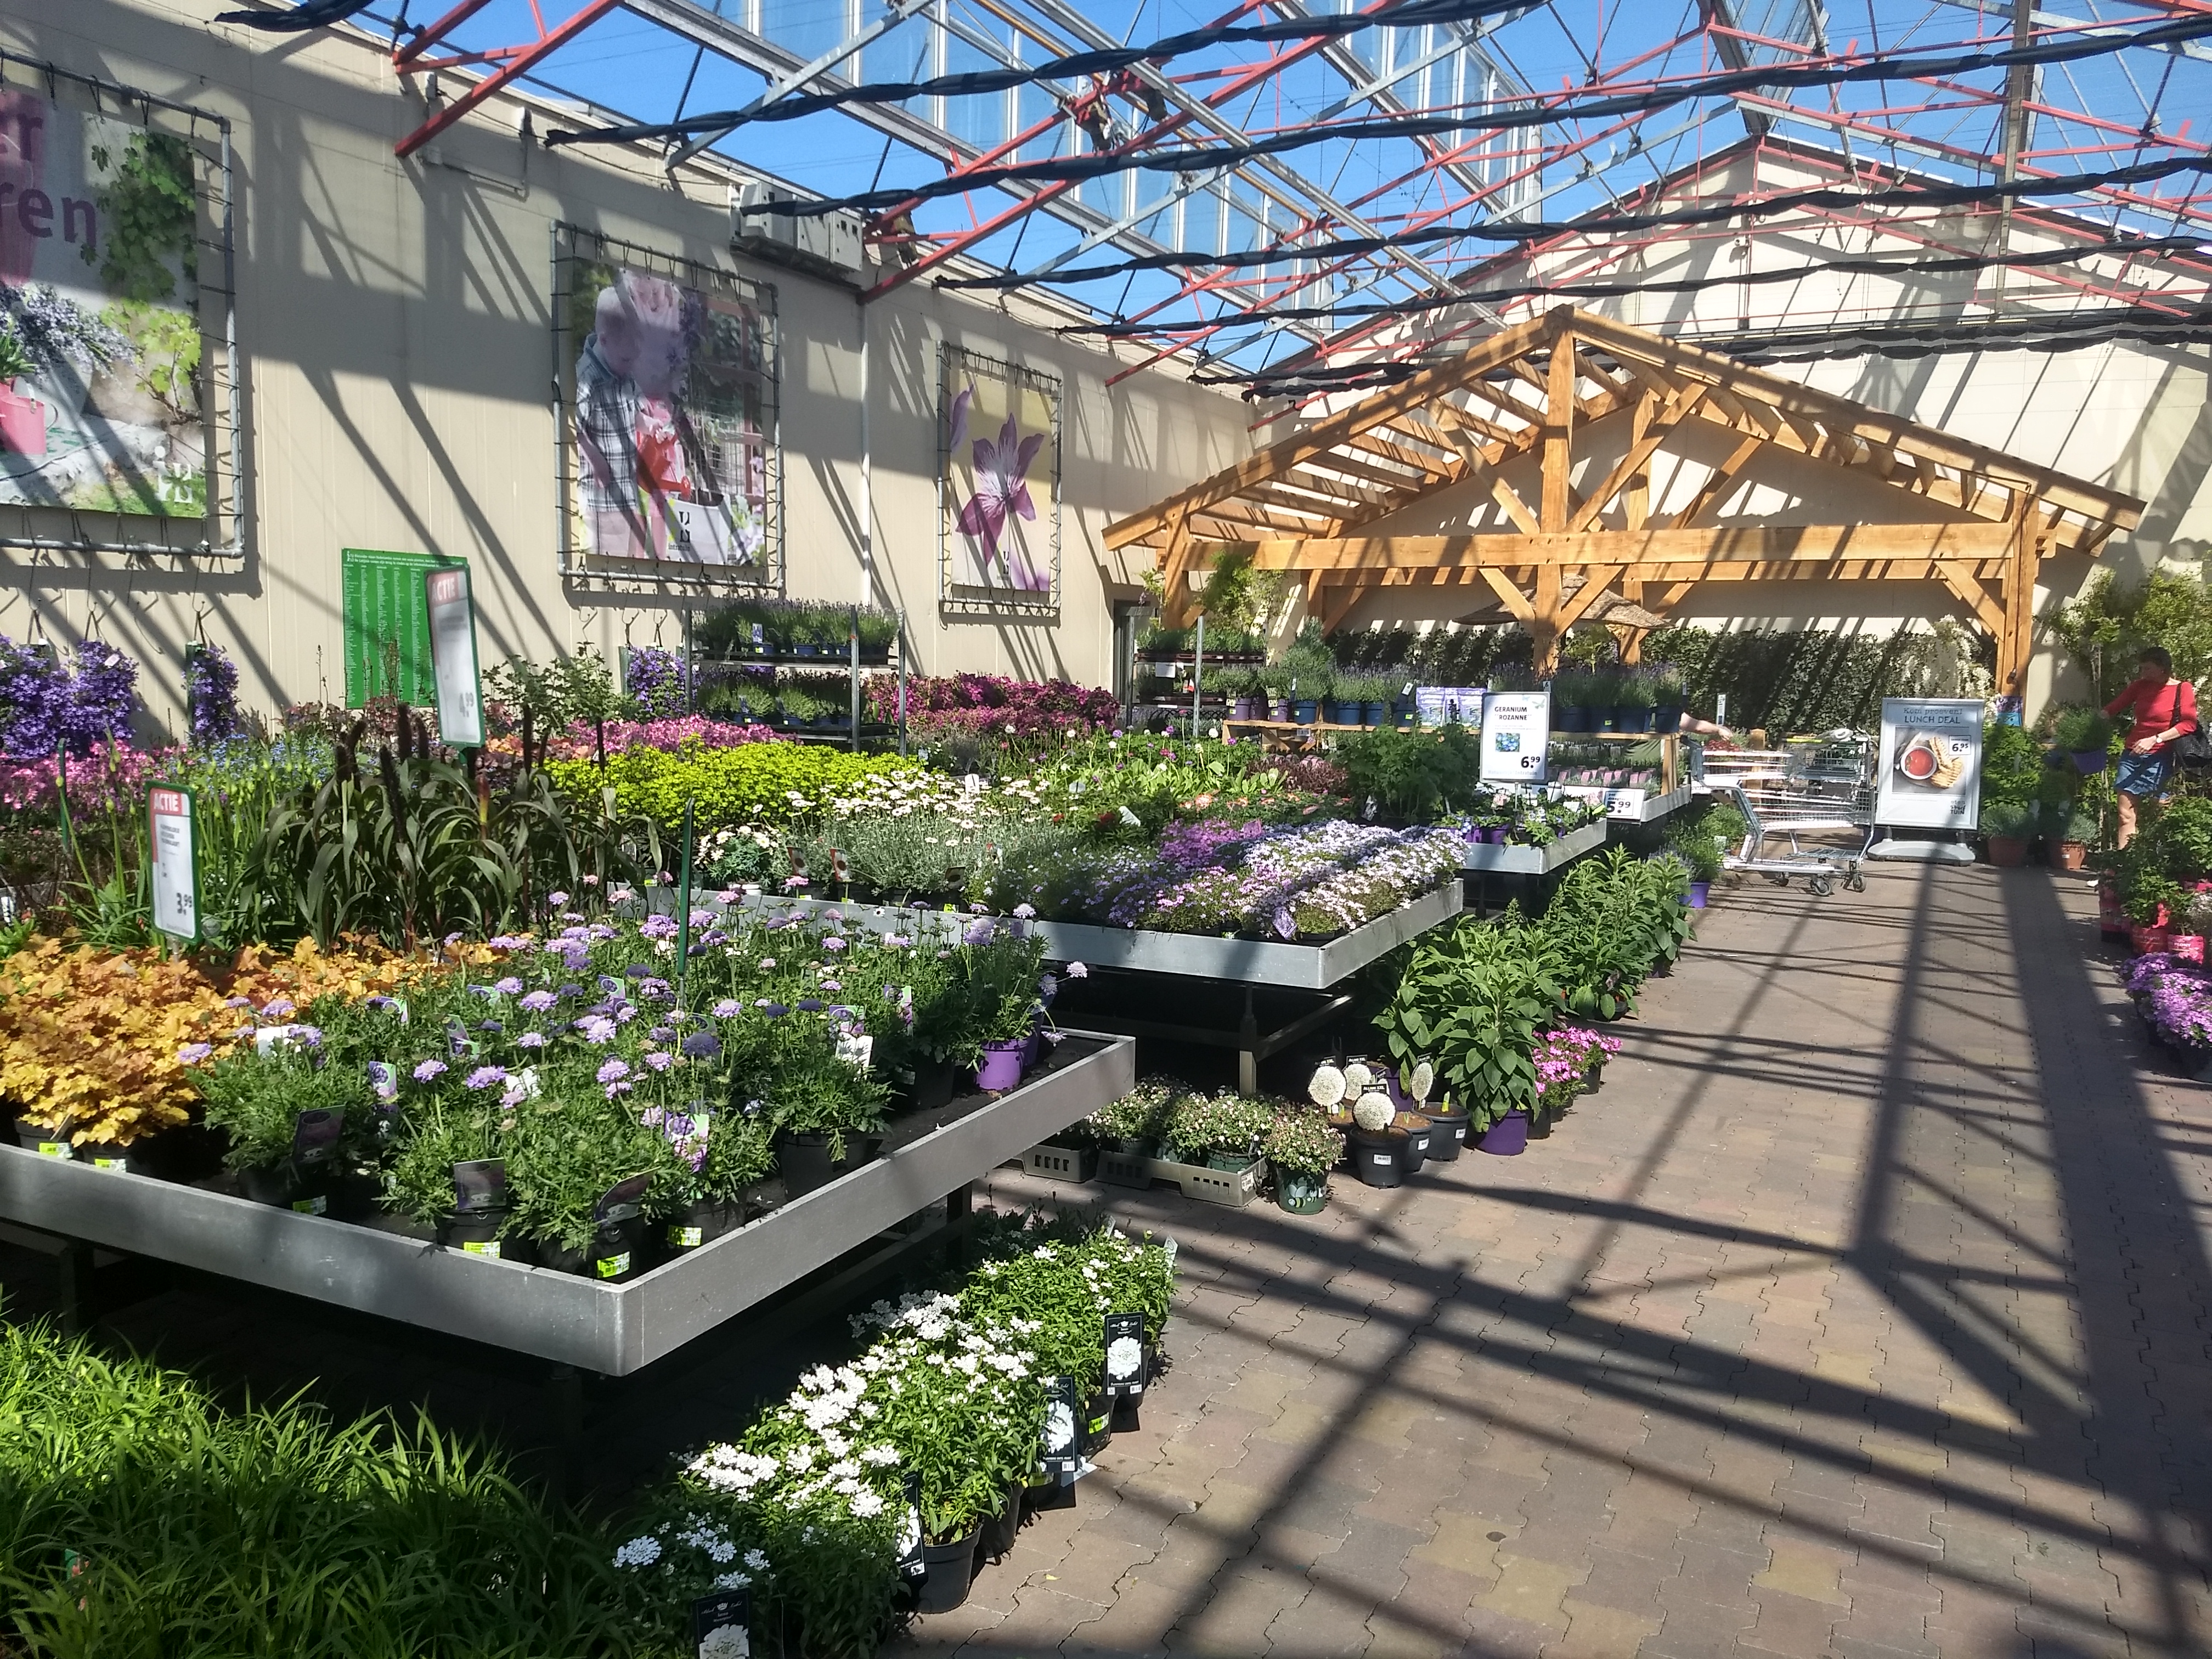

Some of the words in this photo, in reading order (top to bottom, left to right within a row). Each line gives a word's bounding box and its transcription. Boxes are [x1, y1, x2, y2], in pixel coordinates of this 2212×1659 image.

[0, 113, 43, 161] r
[431, 577, 456, 602] ACTIE
[1904, 715, 1934, 724] LUNCH
[1938, 716, 1961, 724] DEAL
[1952, 743, 1968, 752] 6.95
[1521, 756, 1541, 768] 6.99
[154, 793, 179, 812] ACTIE
[1606, 801, 1631, 813] 5.99
[176, 892, 192, 916] 3.99
